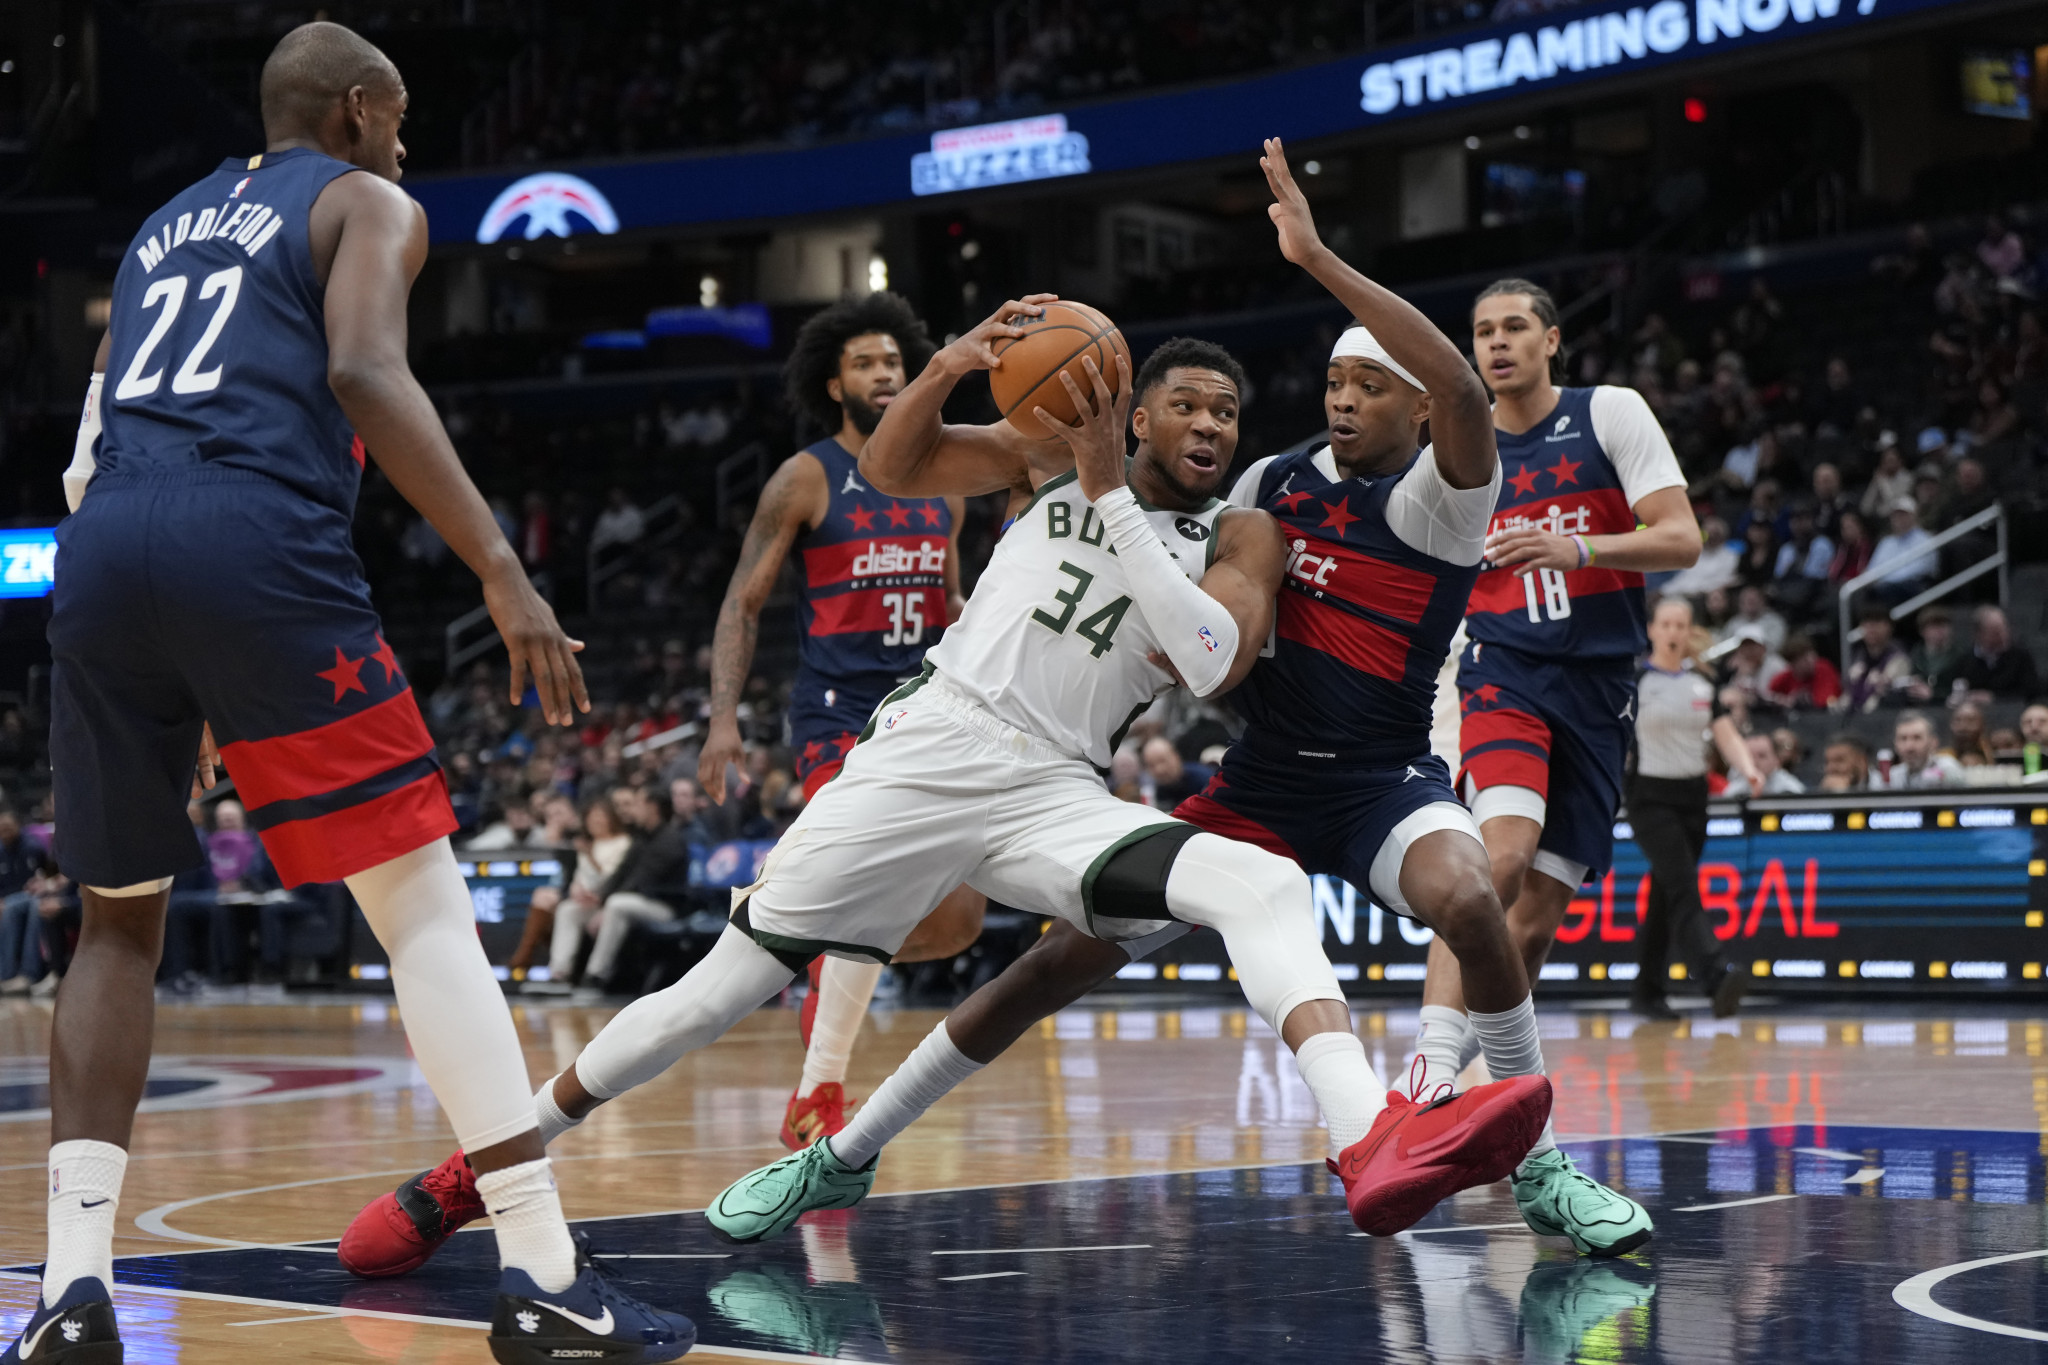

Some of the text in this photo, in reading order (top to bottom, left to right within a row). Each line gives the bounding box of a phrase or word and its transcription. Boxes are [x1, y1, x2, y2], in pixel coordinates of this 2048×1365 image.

[1360, 0, 1690, 114] STREAMING
[914, 138, 1089, 193] BUZZER
[136, 201, 283, 274] MIDDLETON
[115, 264, 243, 400] 22
[1503, 514, 1523, 527] THE
[852, 541, 946, 576] district
[882, 592, 925, 647] 35
[1030, 559, 1134, 661] 34
[1523, 567, 1572, 624] 18
[1298, 750, 1336, 759] WASHINGTON
